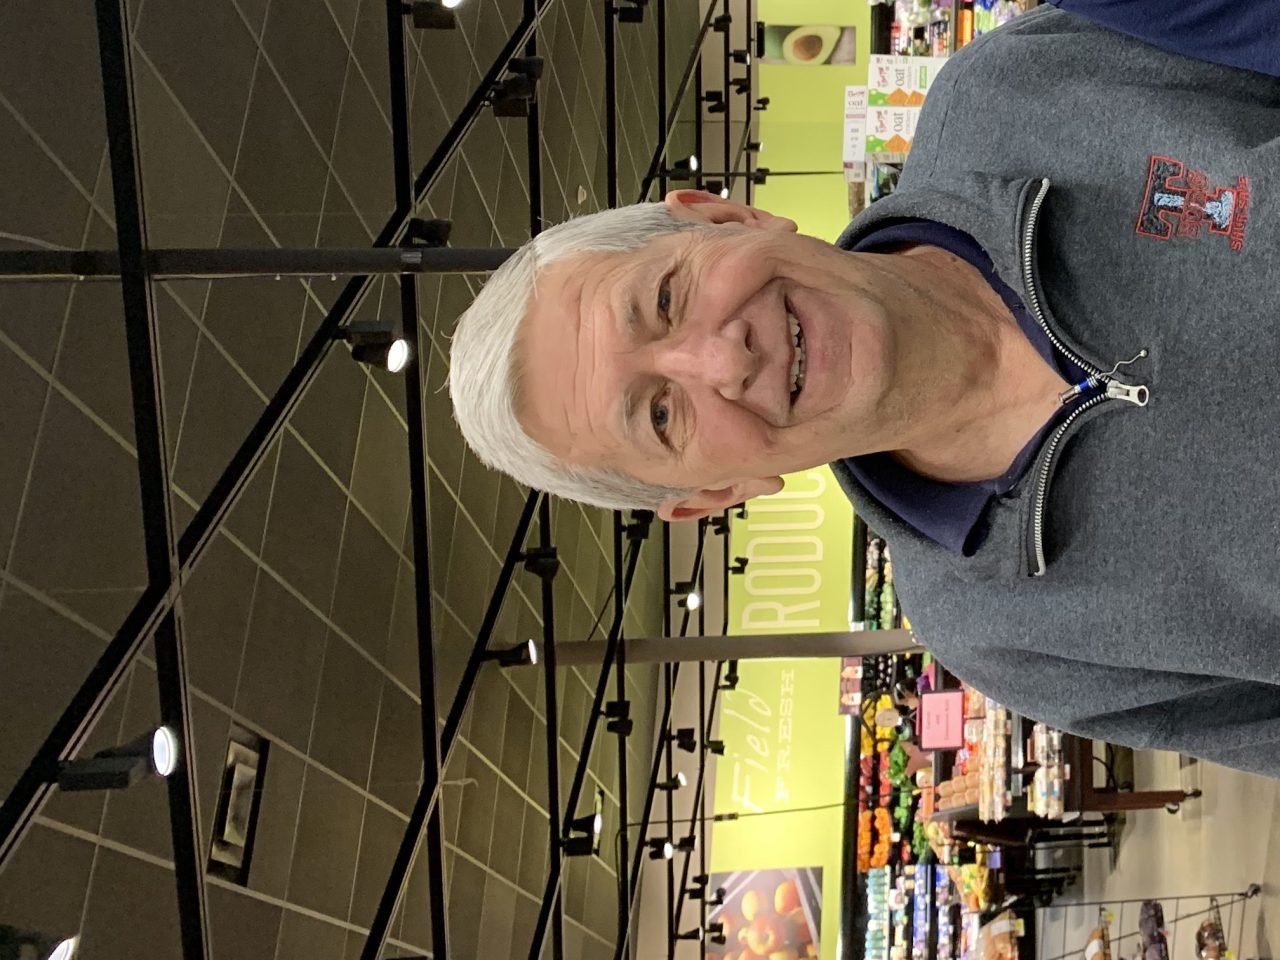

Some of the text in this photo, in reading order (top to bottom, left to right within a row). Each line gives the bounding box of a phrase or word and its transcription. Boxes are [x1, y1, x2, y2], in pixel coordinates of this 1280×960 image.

[894, 67, 905, 87] oat
[892, 111, 904, 132] oat
[723, 688, 772, 813] Field
[775, 668, 795, 801] FRESH
